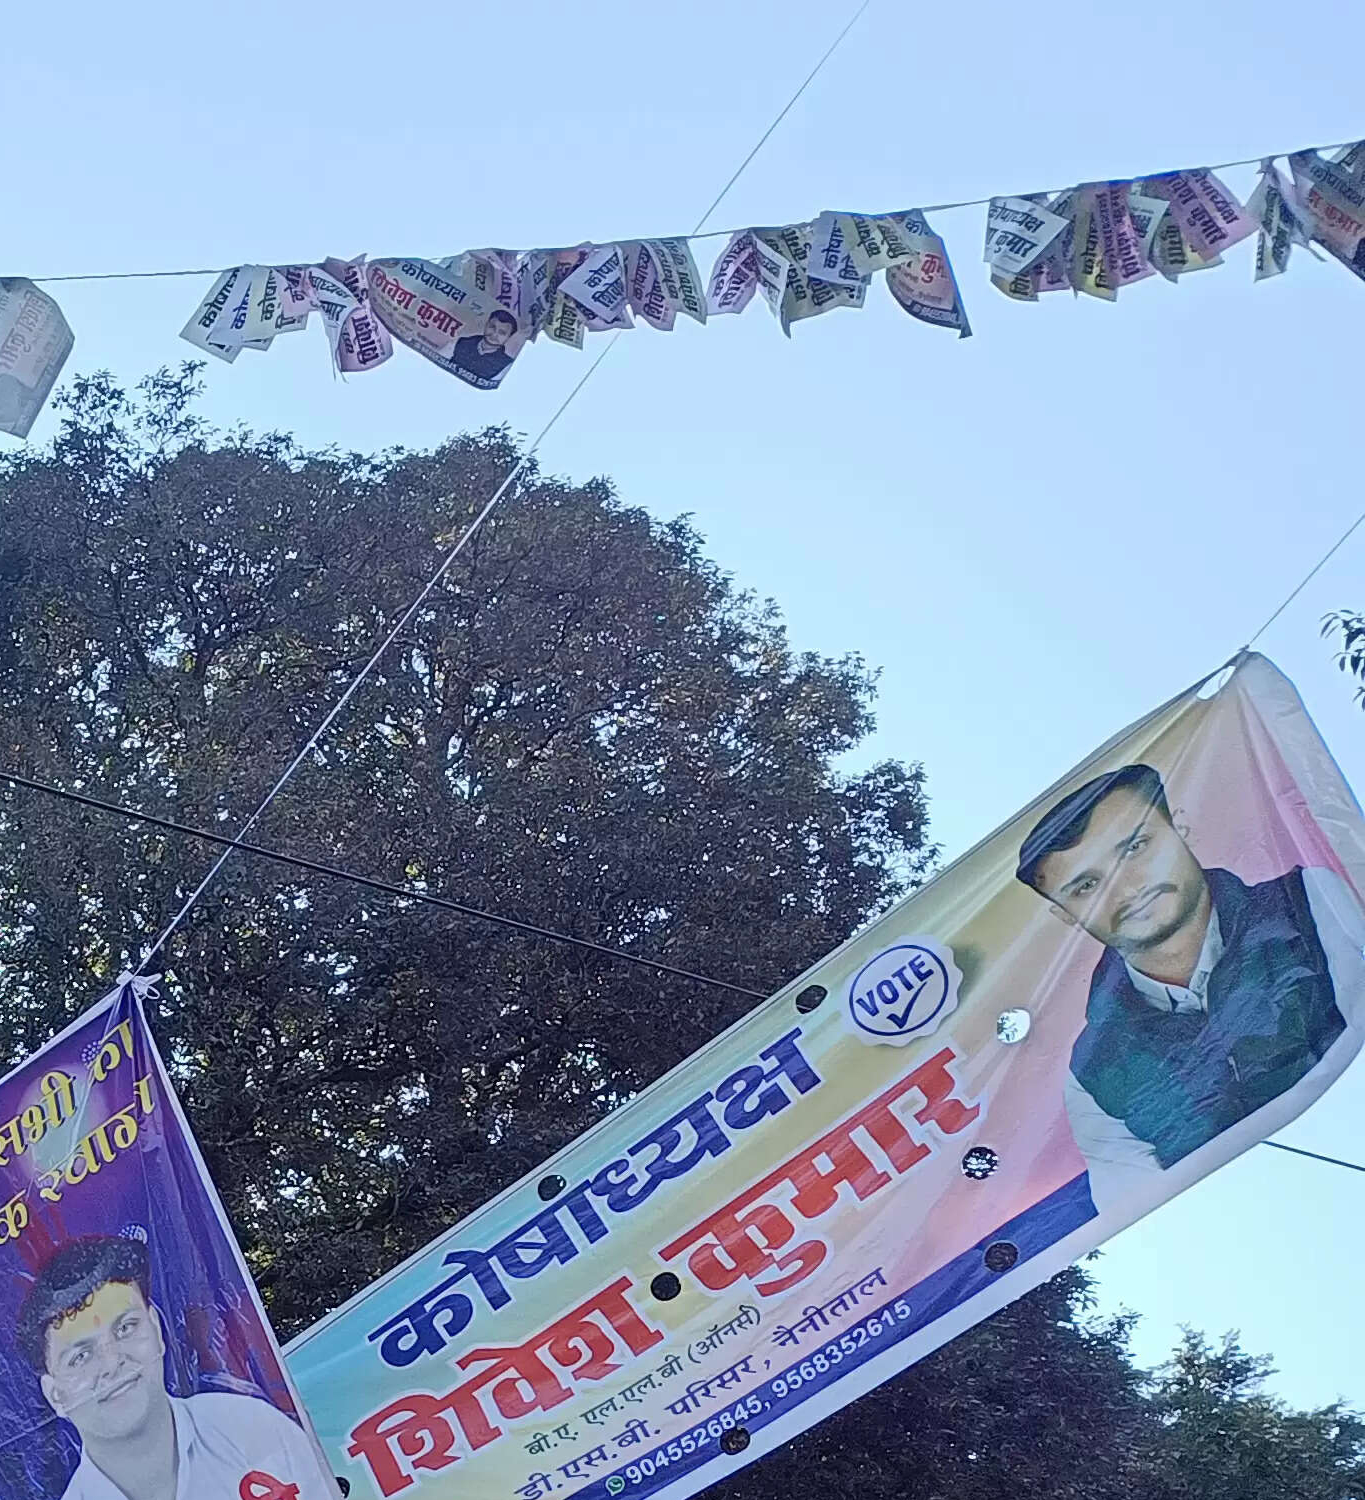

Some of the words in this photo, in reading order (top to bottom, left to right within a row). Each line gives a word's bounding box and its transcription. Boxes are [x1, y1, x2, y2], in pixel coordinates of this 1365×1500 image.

[856, 954, 934, 1016] VOTE
[368, 1028, 822, 1369] कोषाध्यक्ष
[348, 1275, 663, 1496] शिवेश
[659, 1048, 980, 1297] कुमार
[771, 1266, 889, 1349] नैनीताल
[771, 1299, 913, 1397] 9568352615
